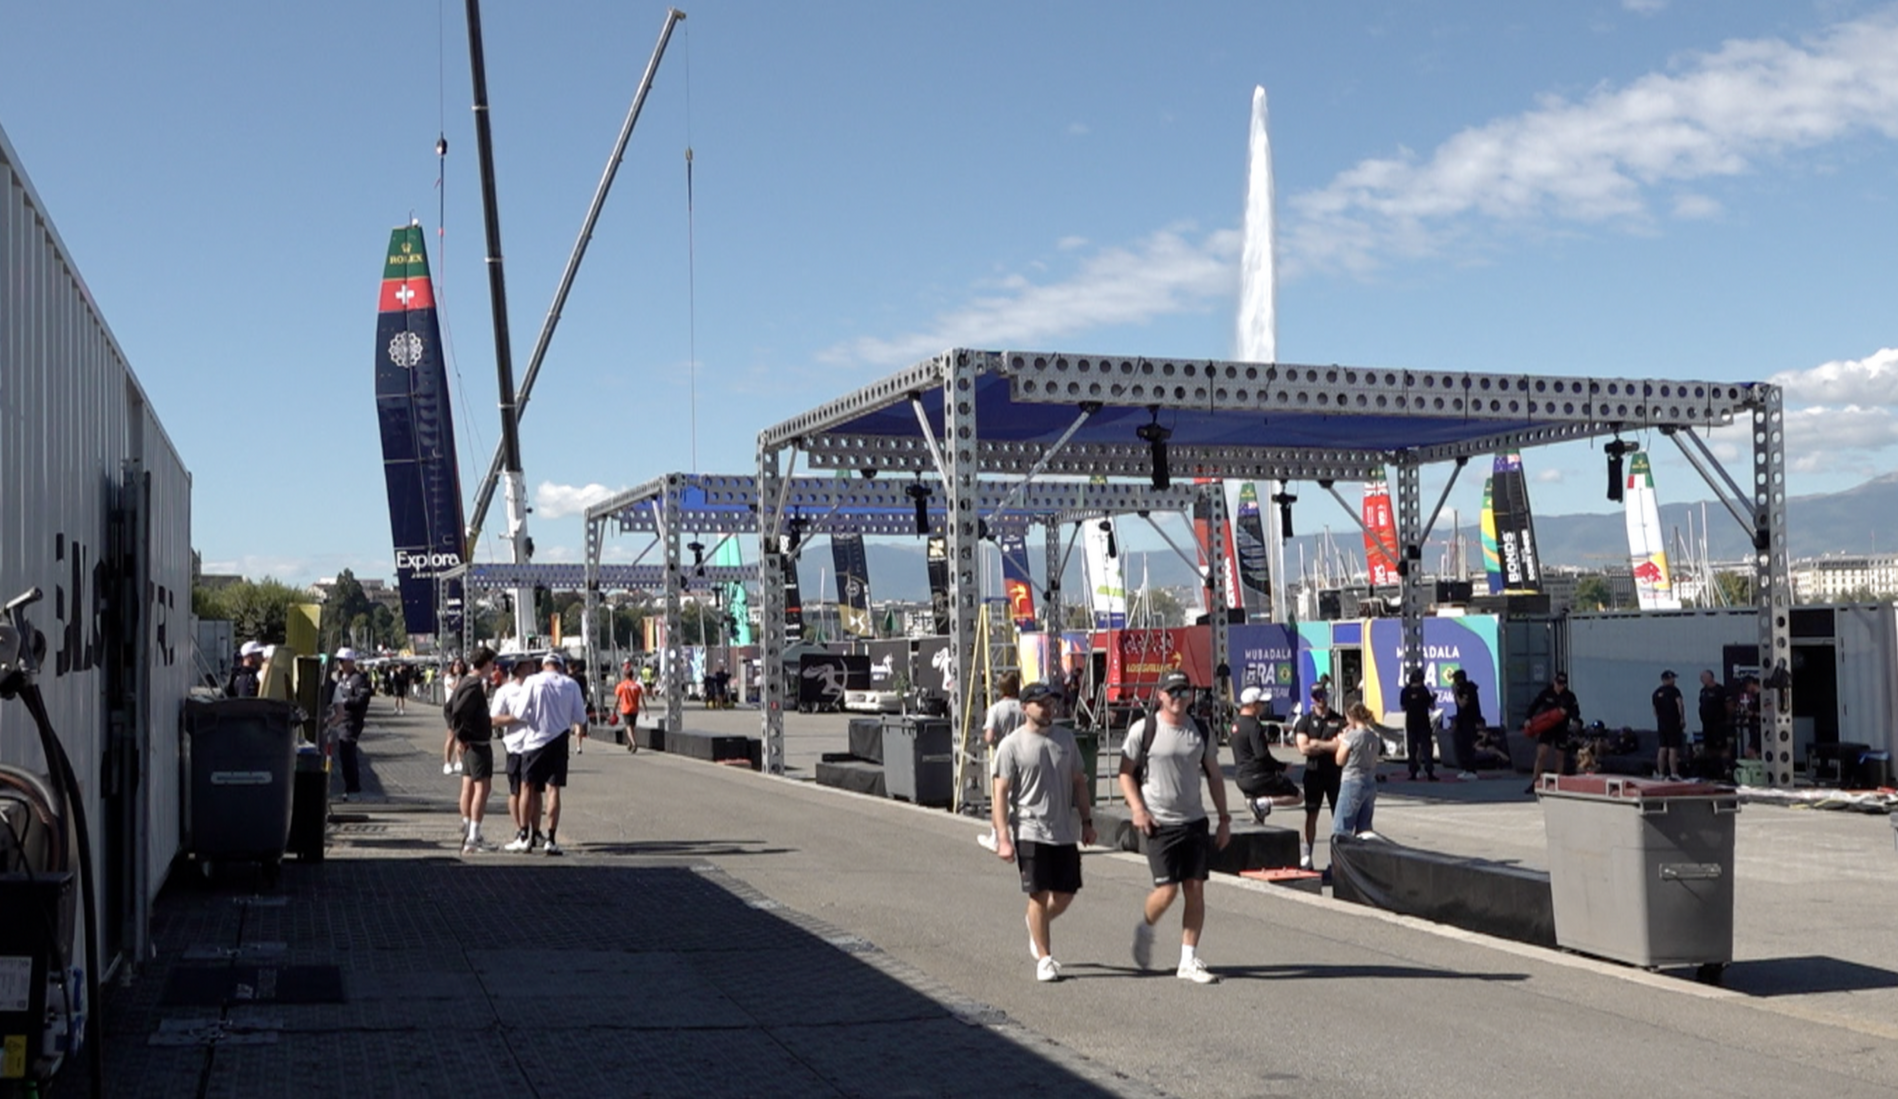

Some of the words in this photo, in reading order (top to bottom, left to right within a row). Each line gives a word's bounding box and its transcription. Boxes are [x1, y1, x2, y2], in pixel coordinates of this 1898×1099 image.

[390, 254, 423, 265] ROLEX
[397, 551, 460, 572] Explora
[1502, 531, 1519, 583] BONDS
[1245, 648, 1292, 660] MUBADALA
[1396, 645, 1460, 659] MADALA
